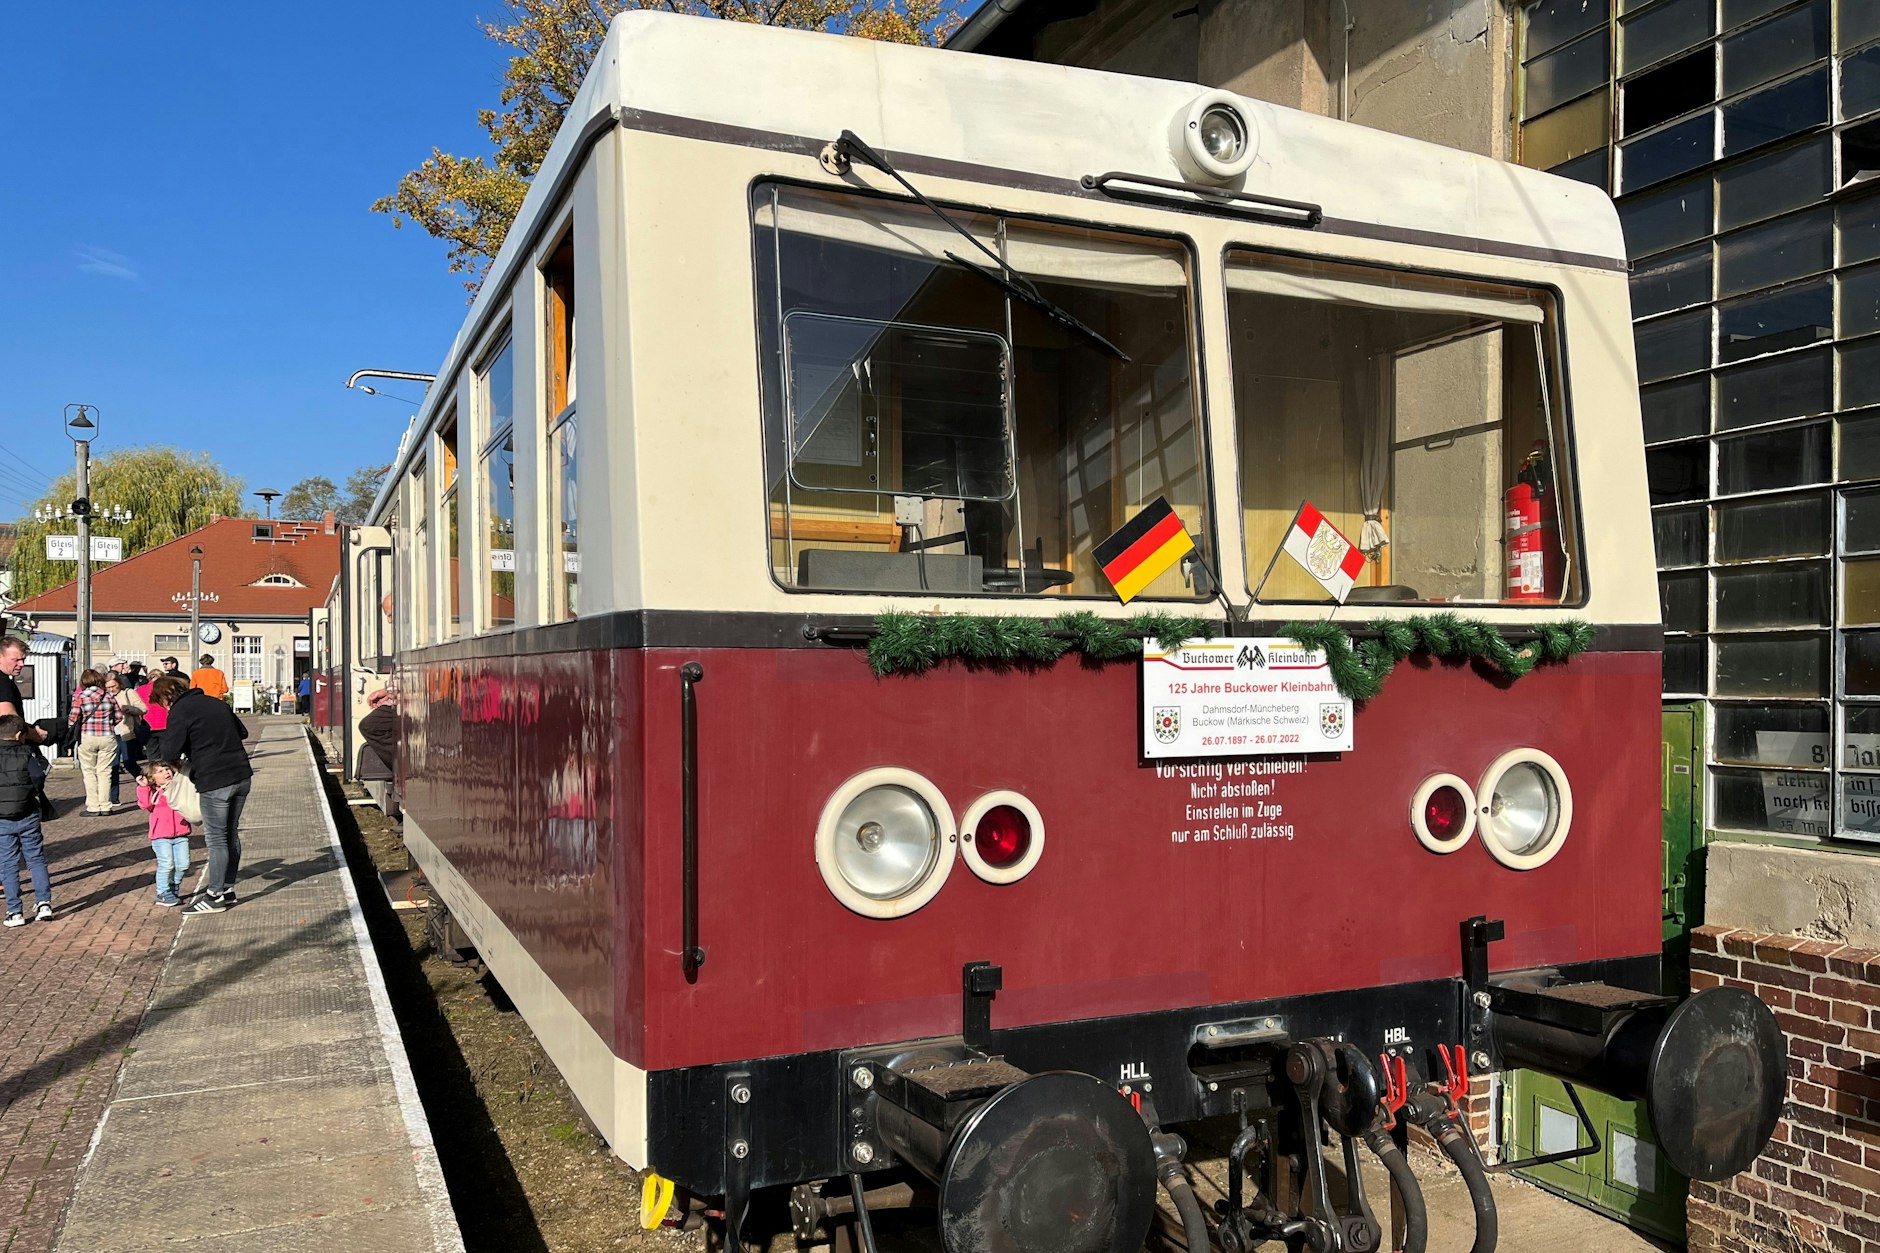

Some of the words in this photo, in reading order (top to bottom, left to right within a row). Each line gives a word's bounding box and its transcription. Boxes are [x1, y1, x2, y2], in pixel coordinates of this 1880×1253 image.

[50, 539, 73, 548] Gleis
[97, 541, 119, 550] Gleis
[58, 548, 64, 556] 2
[1182, 652, 1234, 664] Buckower
[1268, 652, 1316, 664] Kleinbahn
[1168, 683, 1187, 694] 125
[1190, 682, 1221, 694] Jahre
[1224, 682, 1278, 693] Buckower
[1281, 681, 1334, 693] Kleinbahn
[1202, 704, 1299, 714] Dahmsdorf-Müncheberg
[1192, 717, 1225, 727] Buckow
[1227, 716, 1271, 727] (Märkische
[1273, 715, 1309, 725] Schweiz)
[1202, 735, 1247, 745] 26.07.1897
[1255, 734, 1300, 744] 26.07.2022
[1156, 760, 1223, 781] Vorsichtig
[1227, 755, 1308, 776] verschieben!
[1190, 782, 1217, 799] Nicht
[1221, 779, 1275, 798] abstoßen!
[1773, 795, 1808, 812] noch
[1186, 803, 1239, 821] Einstellen
[1242, 803, 1254, 818] im
[1257, 801, 1282, 820] Zuge
[1171, 830, 1190, 843] nur
[1194, 829, 1210, 842] am
[1213, 823, 1248, 841] Schluß
[1251, 822, 1294, 840] zulässig
[1384, 1027, 1410, 1043] HBL
[1120, 1062, 1150, 1080] HLL
